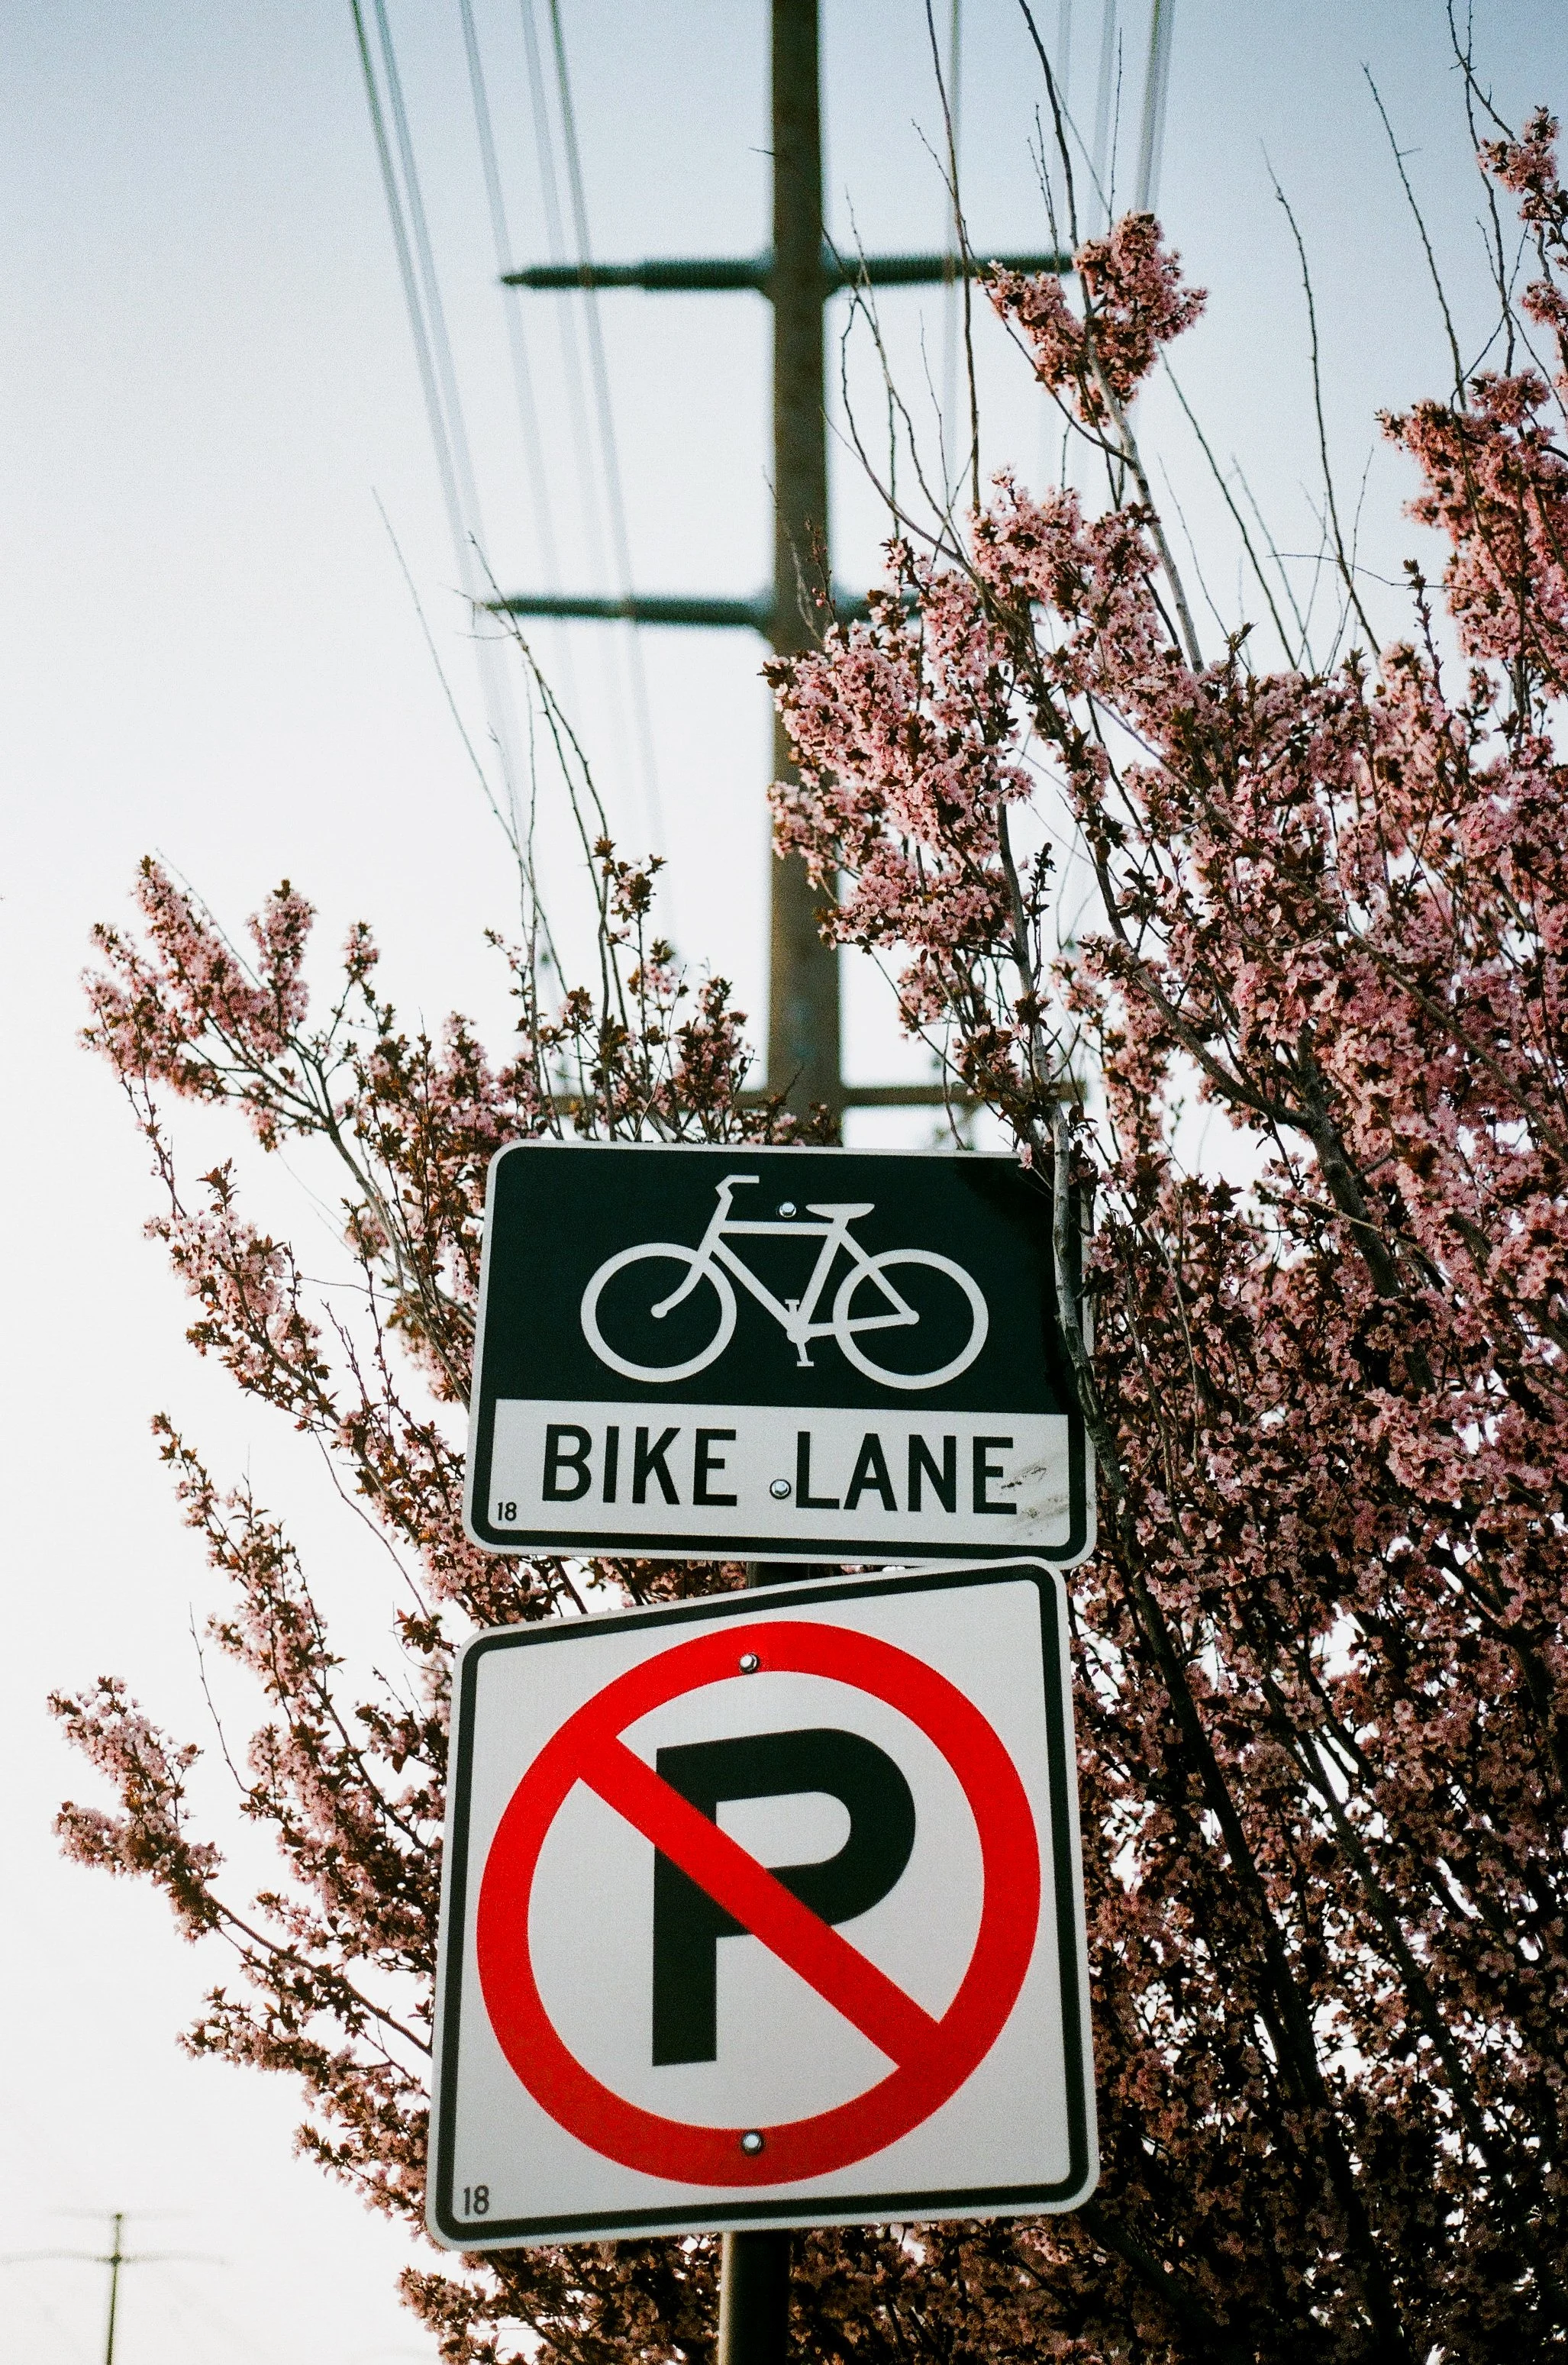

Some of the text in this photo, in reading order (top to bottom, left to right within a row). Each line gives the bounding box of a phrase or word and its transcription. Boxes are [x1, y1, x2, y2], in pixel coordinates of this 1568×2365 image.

[542, 1424, 1017, 1515] BIKE LANE
[497, 1502, 518, 1521] 18
[653, 1728, 916, 2066] P
[463, 2185, 489, 2216] 18
